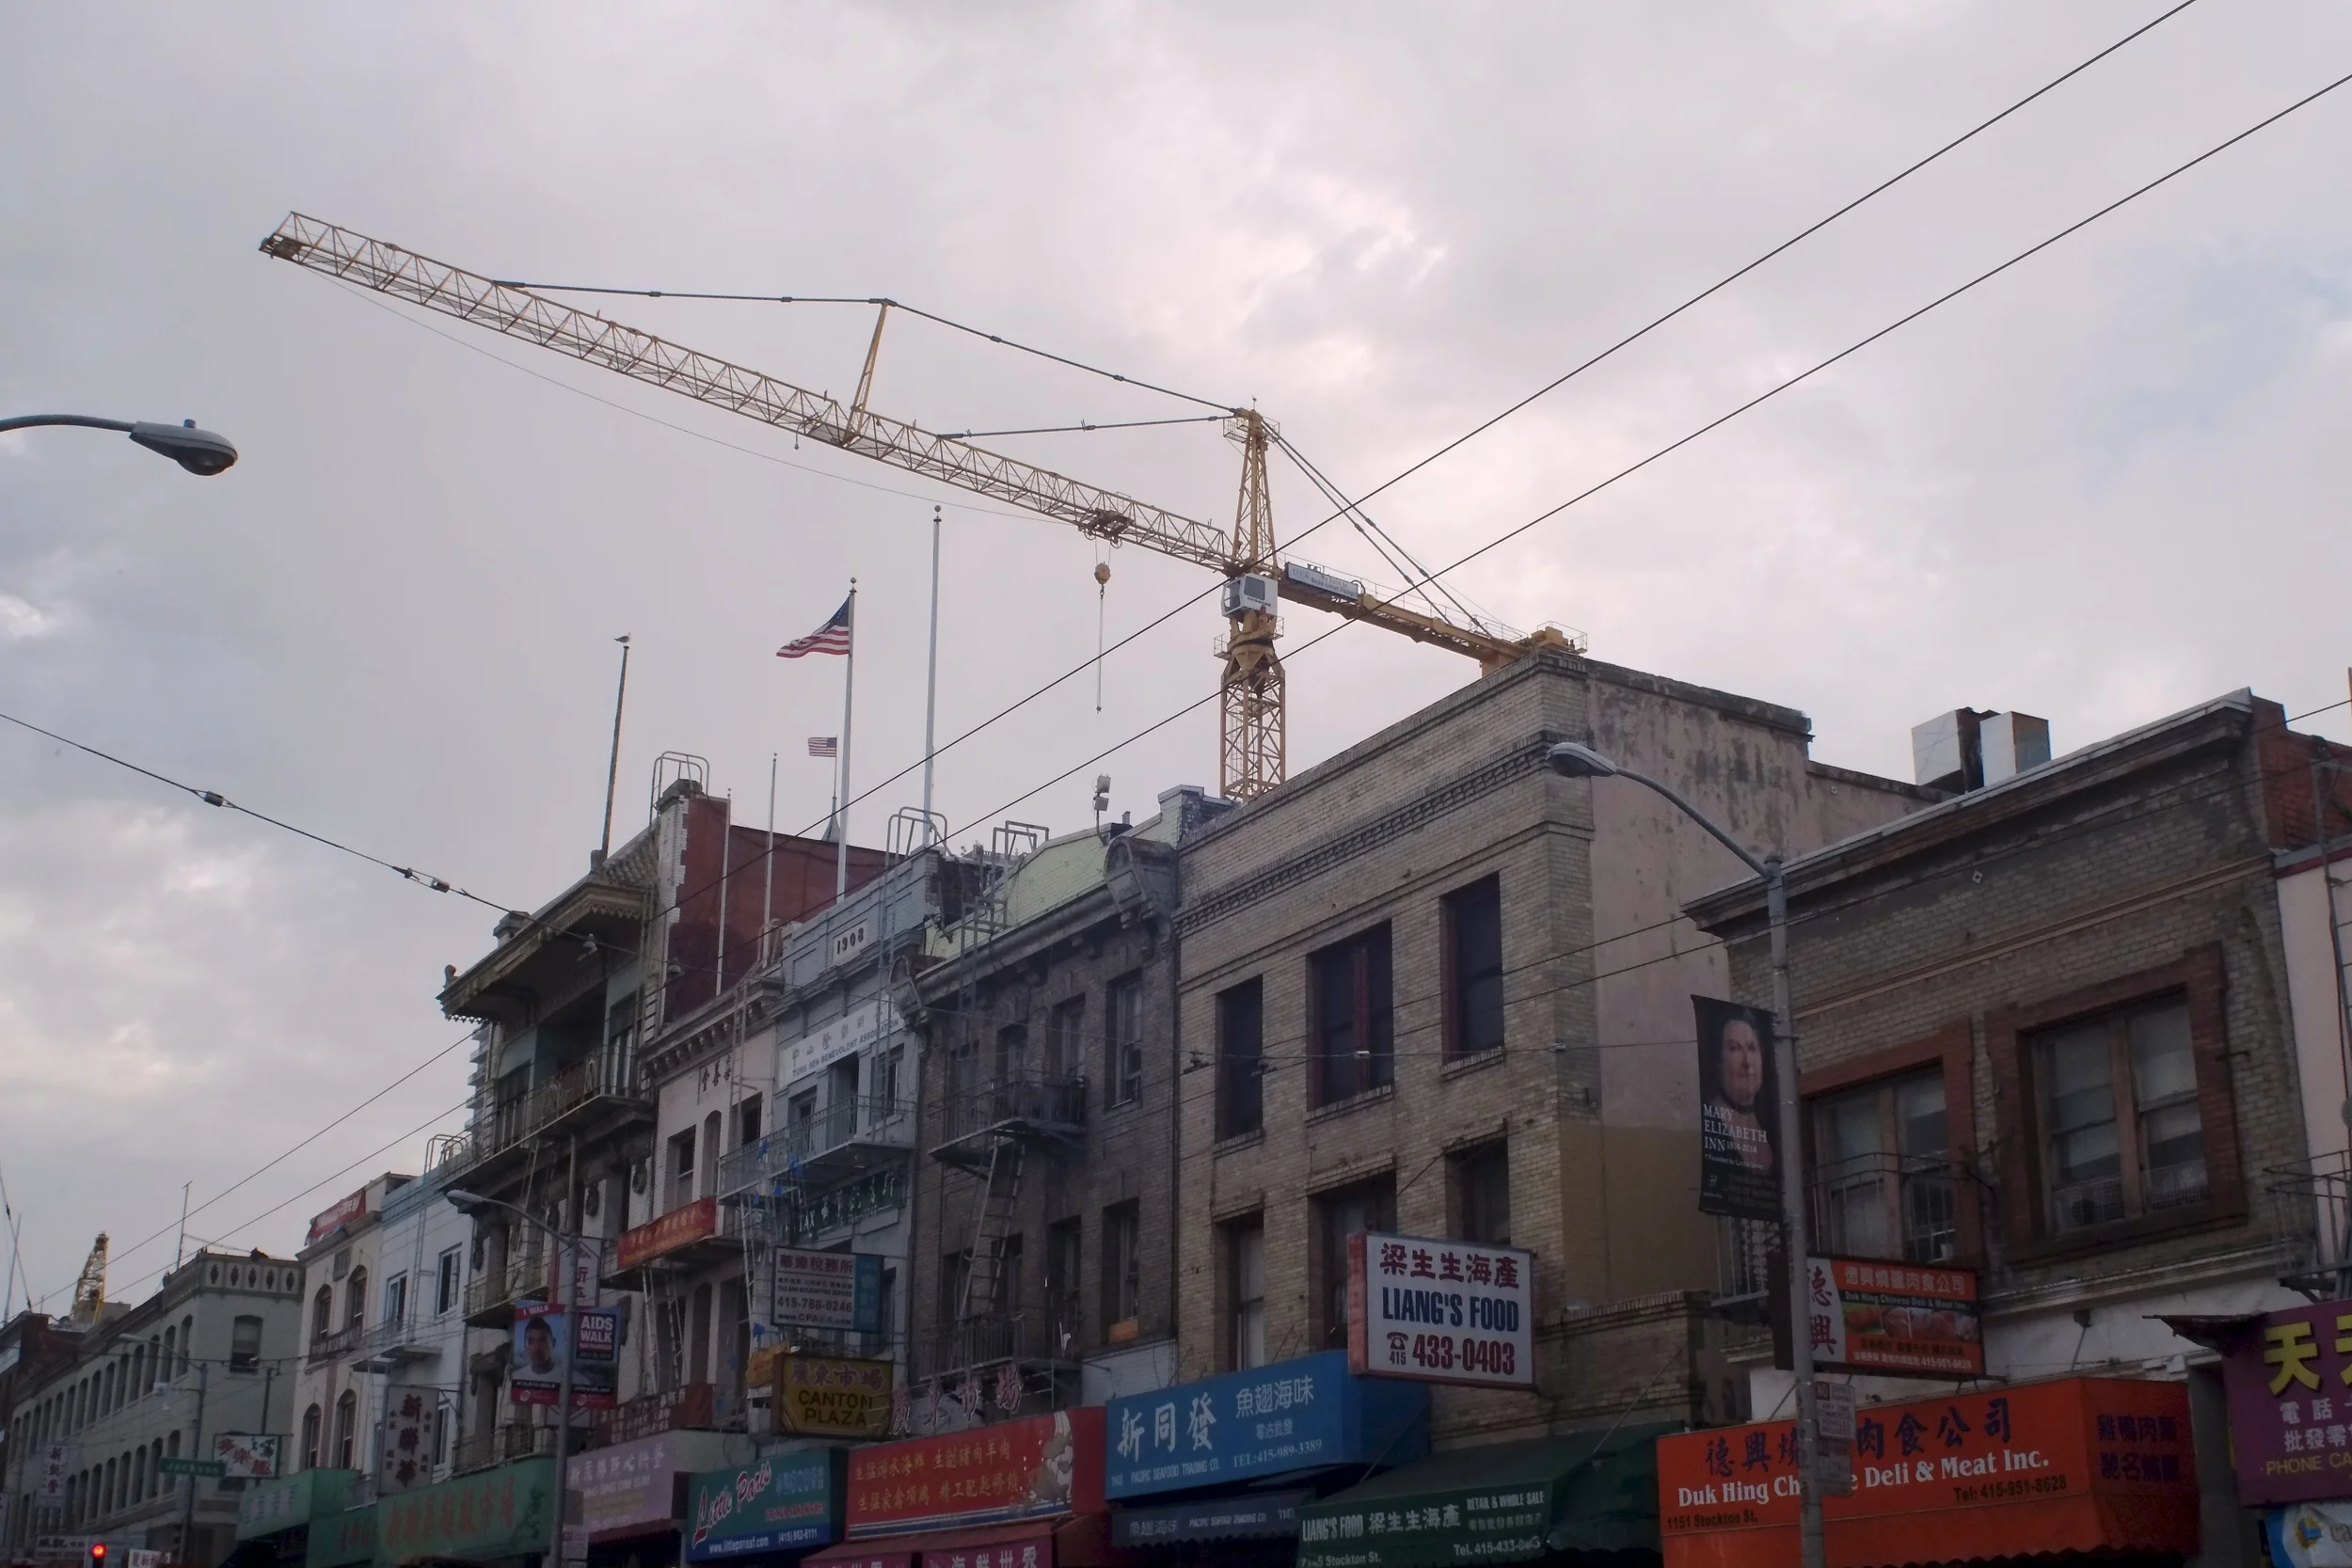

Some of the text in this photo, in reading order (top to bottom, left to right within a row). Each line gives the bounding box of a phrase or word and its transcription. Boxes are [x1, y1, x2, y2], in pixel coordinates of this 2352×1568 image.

[836, 927, 865, 955] 1908
[808, 1059, 820, 1069] SEN
[821, 1038, 858, 1064] BENEVOLENT
[1703, 1103, 1733, 1122] MARY
[1704, 1118, 1768, 1143] ELIZABETH
[1704, 1135, 1725, 1152] INN
[1379, 1242, 1519, 1290] 梁生生海產
[800, 1287, 831, 1295] ACCOUNTING
[1845, 1291, 1858, 1302] Duk
[1860, 1292, 1879, 1305] Hing
[1880, 1294, 1909, 1306] Chinese
[1912, 1297, 1927, 1307] Deli
[1934, 1299, 1953, 1308] Meat
[529, 1304, 550, 1315] WALK
[778, 1296, 852, 1312] 415-788-0246
[1382, 1287, 1519, 1333] LIANG'S FOOD
[580, 1315, 613, 1330] AIDS
[580, 1330, 612, 1343] WALK
[1390, 1334, 1515, 1376] 415 433-0403
[789, 1361, 885, 1392] 廣東市場
[799, 1389, 872, 1410] CANTON
[1235, 1374, 1315, 1419] 魚翅海味
[804, 1408, 867, 1427] PLAZA
[2280, 1396, 2352, 1425] 電話
[1117, 1391, 1216, 1464] 新同發
[1705, 1398, 2011, 1478] 德興燒肉食公司
[2283, 1424, 2352, 1453] 批發零
[1232, 1438, 1323, 1468] TEL:415-989-3389
[166, 1463, 220, 1475] Jackson
[1111, 1457, 1219, 1486] 1143 PACIFIC SEAFOOD TRADING CO.
[2265, 1455, 2323, 1476] PHONE
[618, 1478, 632, 1492] DIM
[633, 1475, 651, 1488] SUM
[1678, 1484, 1718, 1507] Duk
[1722, 1481, 1769, 1505] Hing
[1865, 1461, 1909, 1489] Deli
[1915, 1461, 1935, 1482] &
[1940, 1454, 1997, 1480] Meat
[2003, 1449, 2050, 1473] Inc.
[1953, 1474, 2067, 1503] Tel: 415-951-8628
[692, 1484, 732, 1550] Little
[736, 1459, 772, 1513] Paris
[1466, 1496, 1489, 1511] RETAIL
[1500, 1492, 1524, 1507] WHOLE
[1526, 1490, 1545, 1504] SALE
[1188, 1516, 1210, 1528] PACIFIC
[1210, 1514, 1232, 1528] SEAFOOD
[1232, 1513, 1256, 1525] TRADING
[1302, 1513, 1364, 1543] LIANG'S FOOD
[1368, 1503, 1461, 1534] 梁生生海產
[1667, 1508, 1758, 1529] 1151 Stockton St.
[779, 1531, 793, 1544] (415)
[1326, 1554, 1366, 1567] Stockton
[1368, 1551, 1381, 1563] St.
[1453, 1543, 1472, 1558] Tel.
